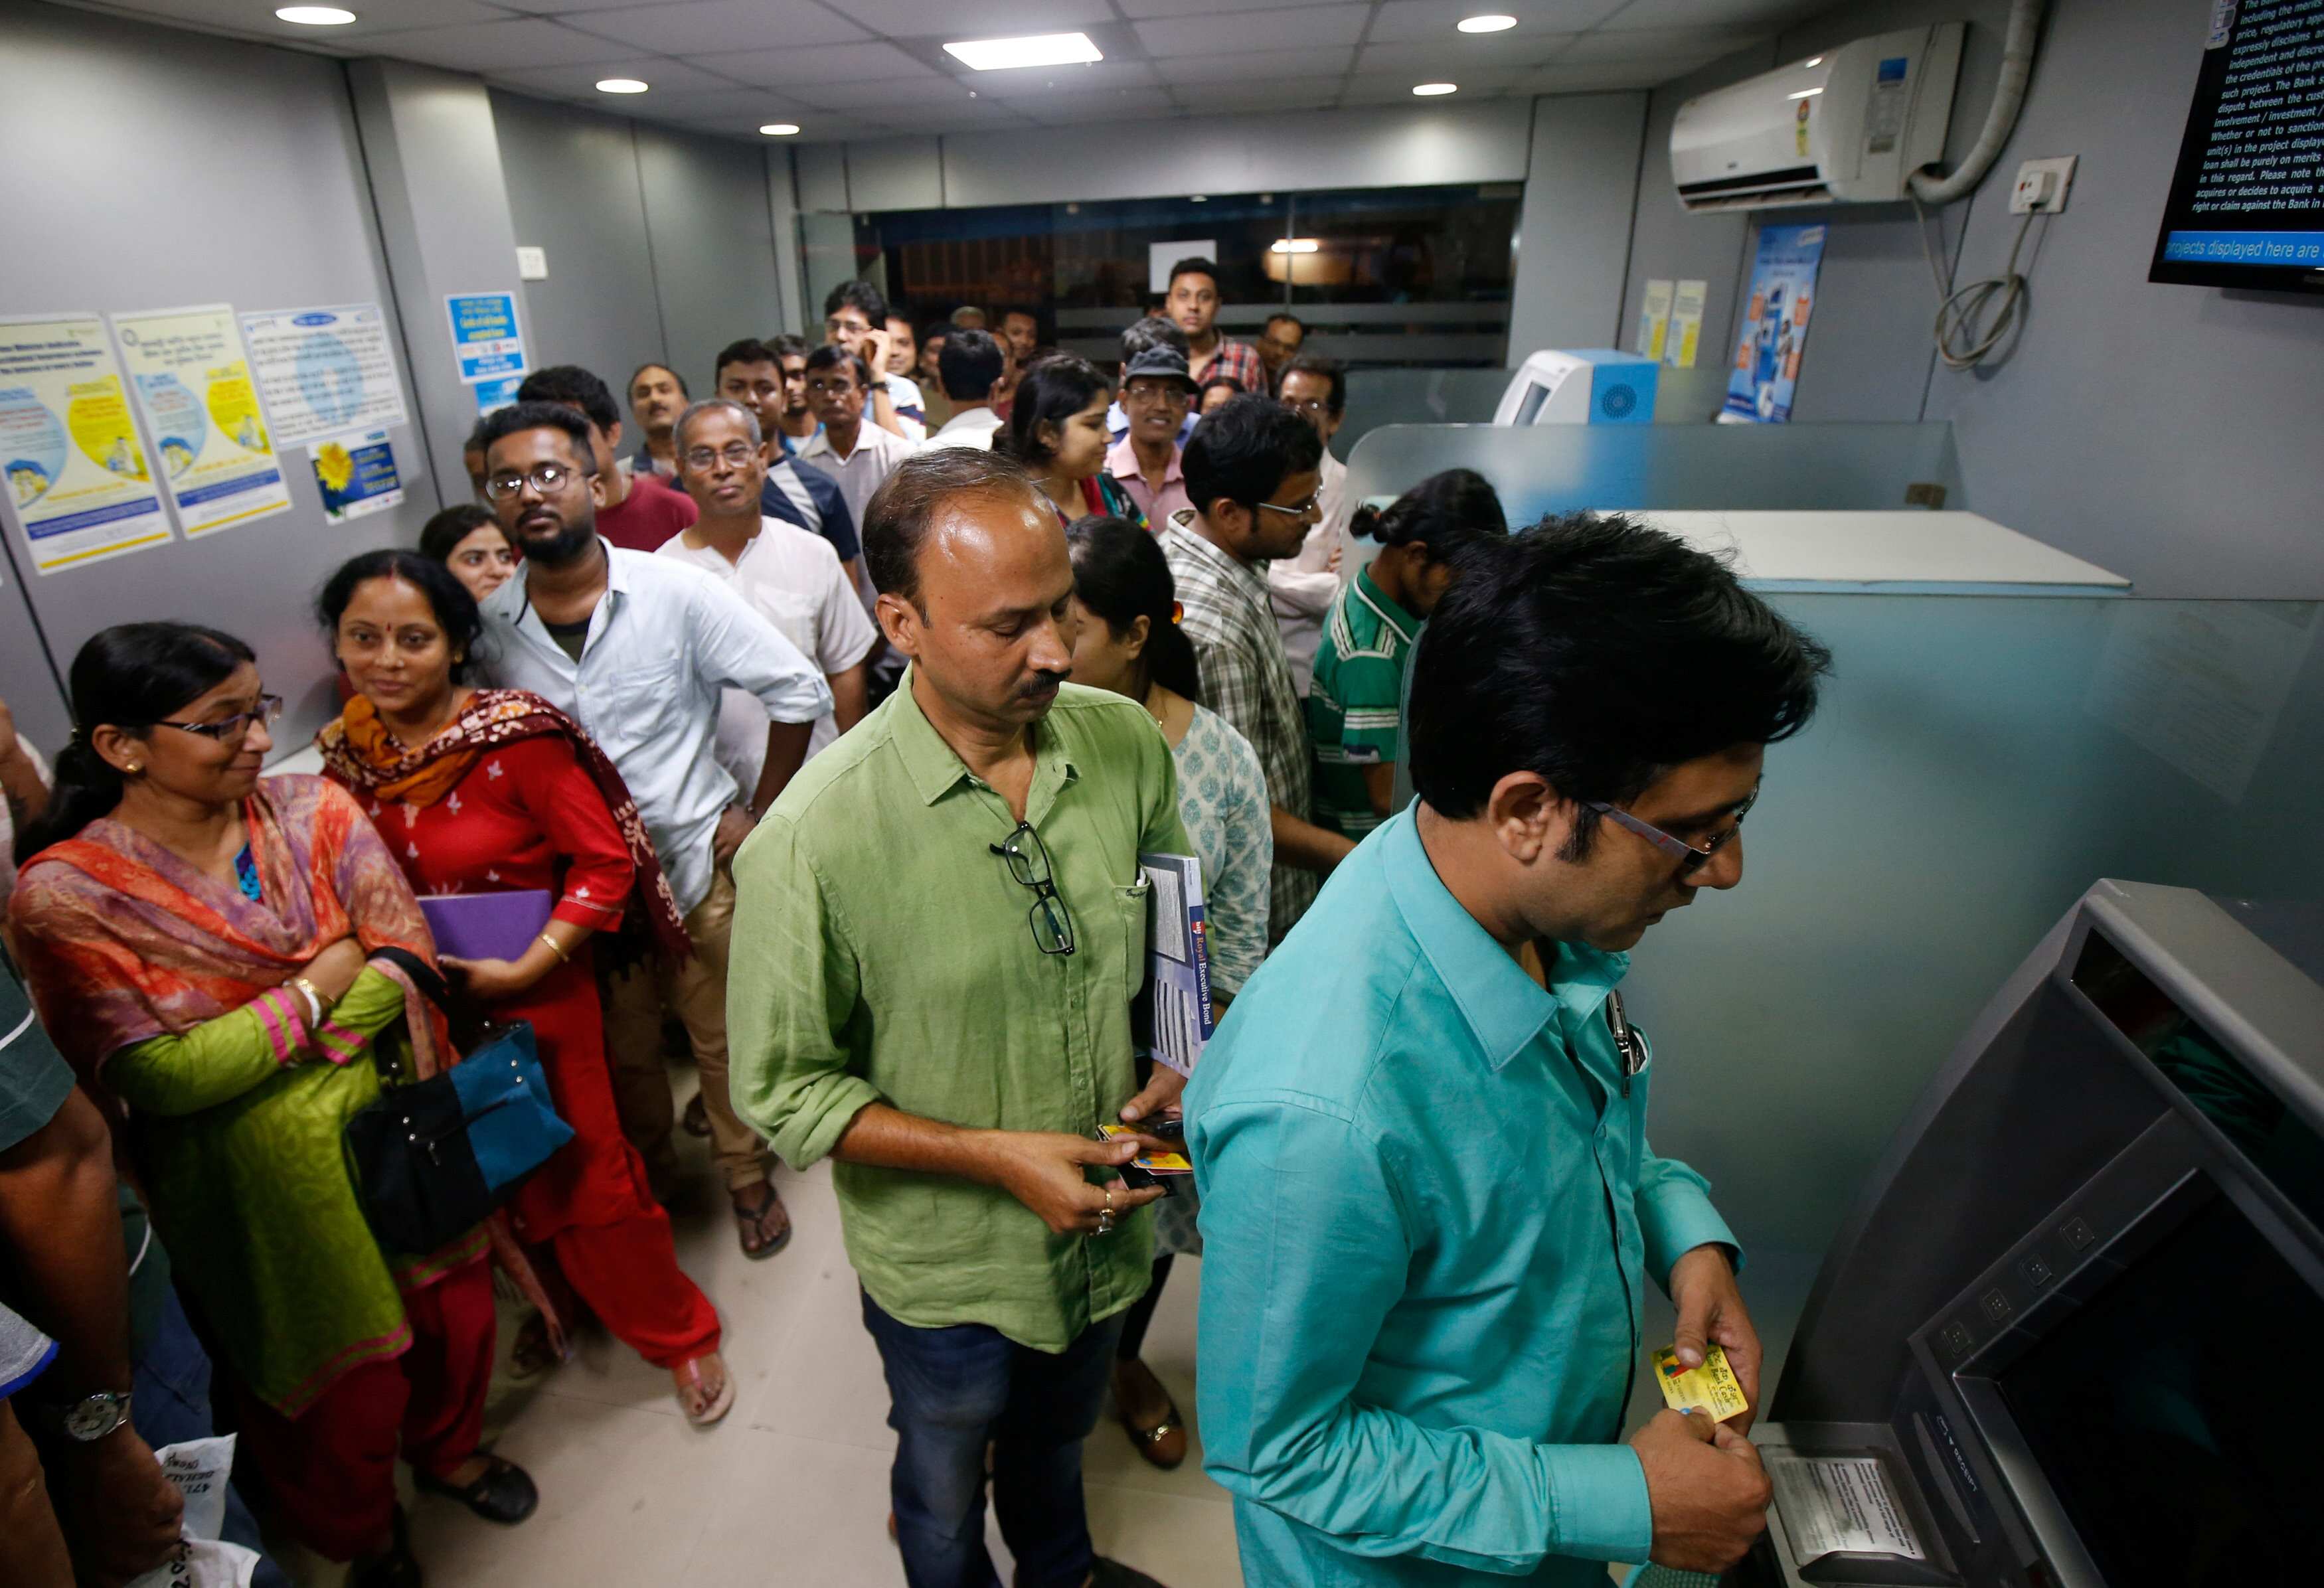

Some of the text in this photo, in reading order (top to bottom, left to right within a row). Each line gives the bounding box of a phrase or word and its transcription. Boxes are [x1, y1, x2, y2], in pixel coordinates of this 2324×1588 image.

[2240, 10, 2276, 25] including
[2279, 6, 2292, 17] the
[2245, 1, 2259, 10] The
[2236, 28, 2258, 42] price,
[2261, 17, 2304, 35] regulatory
[2232, 39, 2270, 56] expressly
[2272, 31, 2311, 48] disclaims
[2228, 52, 2278, 70] independent
[2279, 48, 2295, 61] and
[2225, 74, 2238, 85] the
[2240, 67, 2283, 82] credentials
[2285, 62, 2295, 74] of
[2296, 61, 2311, 72] the
[2221, 88, 2239, 100] such
[2241, 83, 2272, 98] project.
[2276, 80, 2291, 91] The
[2293, 75, 2316, 88] Bank
[2218, 102, 2246, 114] dispute
[2249, 98, 2283, 110] between
[2287, 93, 2301, 104] the
[2214, 114, 2261, 128] involvement
[2269, 106, 2316, 121] investment
[2210, 130, 2242, 142] Whether
[2246, 129, 2255, 138] or
[2258, 126, 2272, 137] not
[2276, 125, 2284, 135] to
[2206, 144, 2233, 157] unit(s)
[2234, 144, 2242, 154] in
[2244, 143, 2258, 153] the
[2259, 140, 2289, 154] project
[2203, 152, 2321, 170] loan shall be purely on merits
[2199, 173, 2207, 184] in
[2210, 173, 2224, 183] this
[2228, 171, 2255, 184] regard.
[2260, 170, 2287, 181] Please
[2291, 168, 2311, 179] note
[2195, 187, 2226, 199] acquires
[2228, 188, 2236, 197] or
[2238, 185, 2268, 197] decides
[2270, 185, 2279, 195] to
[2280, 183, 2313, 196] acquire
[2191, 198, 2321, 213] right or claim against the Bank in
[2208, 239, 2264, 260] displayed
[2265, 240, 2294, 258] here
[2297, 244, 2320, 259] are
[1195, 937, 1206, 961] Royal
[1199, 963, 1209, 1002] Executive
[1203, 1003, 1212, 1024] Bond
